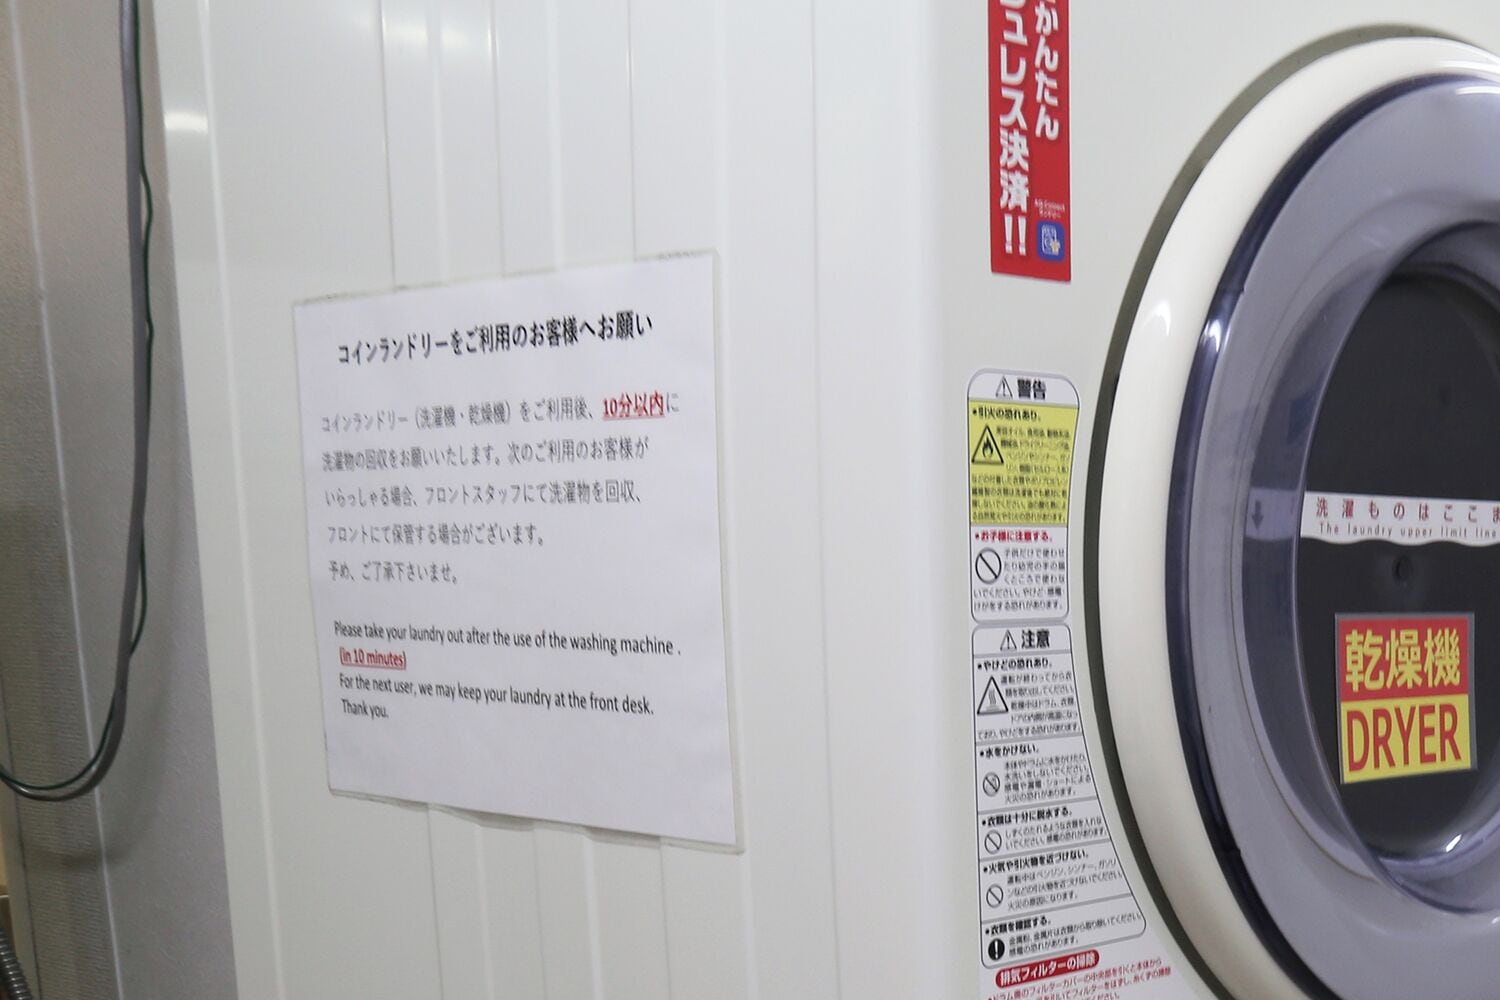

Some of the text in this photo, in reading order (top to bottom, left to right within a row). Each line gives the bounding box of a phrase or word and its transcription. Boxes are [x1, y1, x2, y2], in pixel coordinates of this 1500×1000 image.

[1034, 0, 1059, 141] かんたん
[1017, 379, 1046, 400] 警告
[1318, 522, 1498, 539] The laundry upper limit line
[334, 620, 674, 656] Please take your laundry out after the use of the washing machine
[1021, 629, 1050, 649] 注意
[354, 649, 365, 664] 10
[366, 649, 407, 669] minutes)
[1345, 627, 1461, 693] 乾燥機
[339, 672, 654, 715] For the next user, we may keep your laundry at the front desk.
[341, 698, 389, 720] Thank you.
[1346, 703, 1462, 772] DRYER
